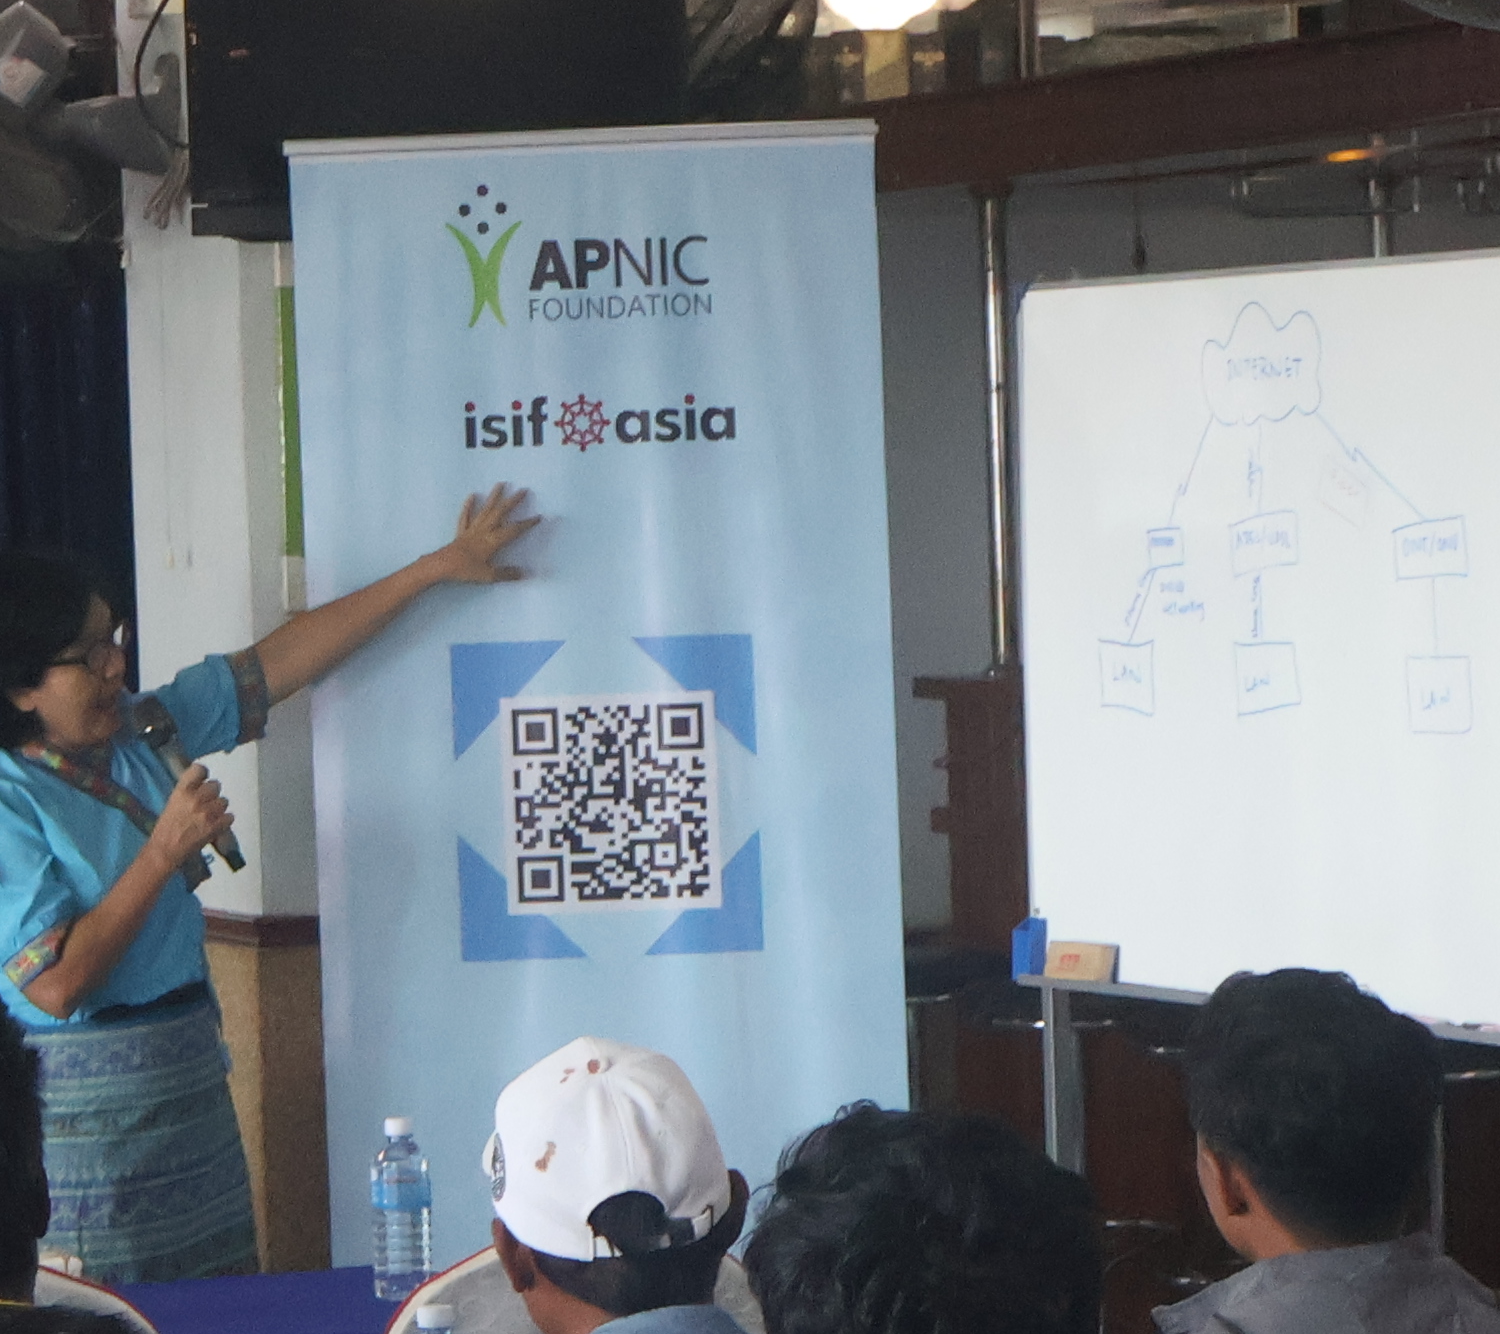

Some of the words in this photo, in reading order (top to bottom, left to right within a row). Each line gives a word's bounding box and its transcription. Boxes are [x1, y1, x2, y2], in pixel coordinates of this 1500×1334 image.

[530, 235, 710, 291] APNIC
[529, 293, 713, 322] FOUNDATION
[464, 396, 549, 449] isif
[615, 394, 737, 444] asia
